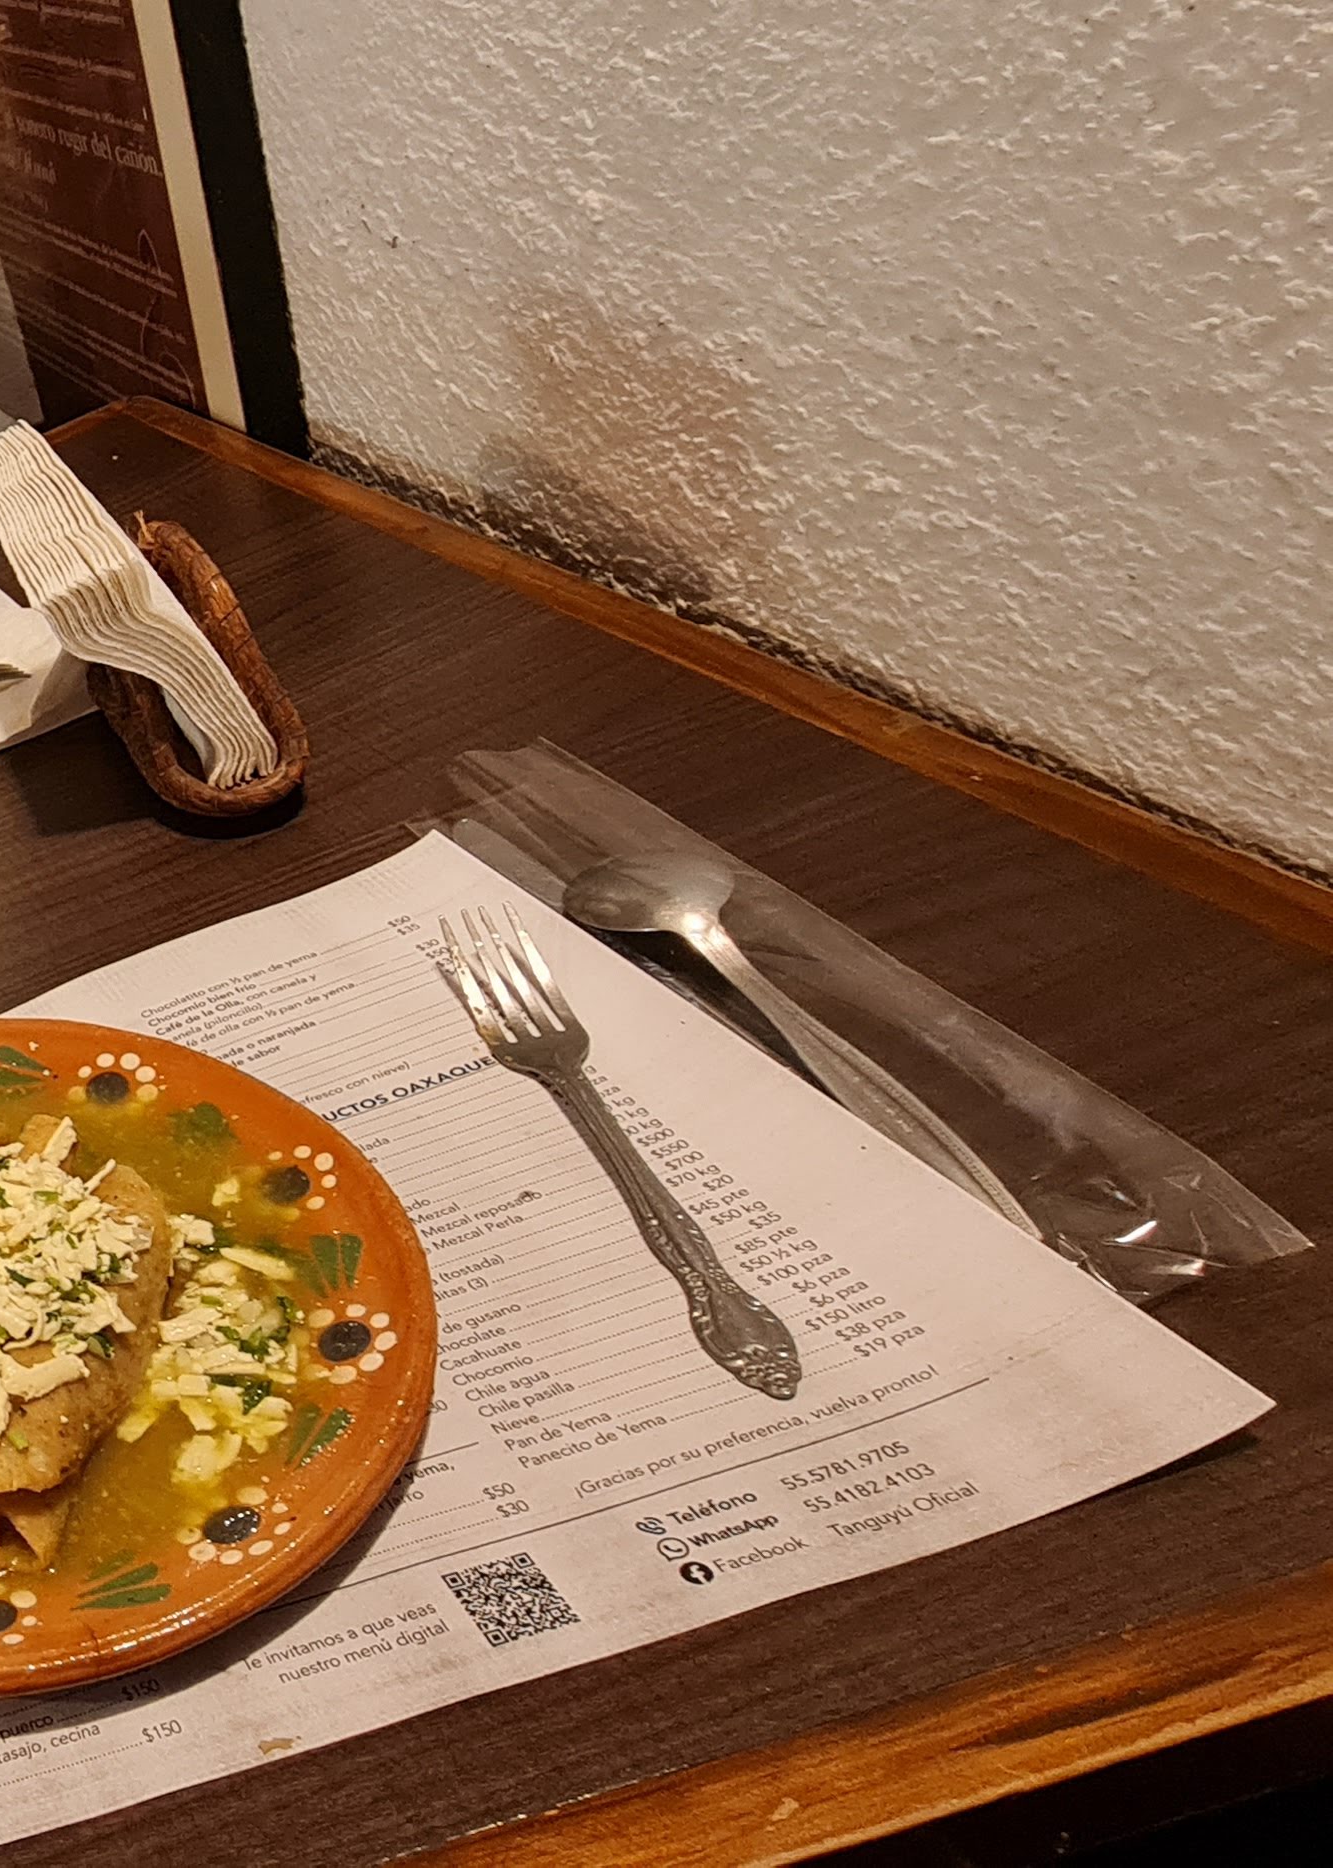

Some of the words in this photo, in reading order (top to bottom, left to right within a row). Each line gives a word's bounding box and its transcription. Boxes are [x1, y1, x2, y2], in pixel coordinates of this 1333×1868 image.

[140, 990, 206, 1018] Chocolatito
[207, 982, 229, 992] con
[243, 969, 266, 981] pan
[267, 963, 283, 972] de
[284, 952, 317, 967] yema
[387, 915, 411, 927] $50
[321, 1093, 388, 1124] UCTOS
[391, 1052, 496, 1097] OAXAQUE
[420, 1213, 472, 1237] Mezcal
[473, 1190, 542, 1220] reposado
[650, 1139, 689, 1159] $550
[431, 1226, 484, 1250] Mezcal
[483, 1215, 524, 1232] Perla
[664, 1150, 704, 1170] $700
[438, 1253, 505, 1283] (tostada)
[702, 1174, 734, 1191] $20
[439, 1340, 522, 1370] Cacahuate
[739, 1254, 773, 1272] $50
[789, 1239, 818, 1252] kg
[451, 1356, 533, 1385] Chocomío
[756, 1264, 799, 1286] $100
[800, 1253, 833, 1272] pza
[464, 1383, 507, 1401] Chile
[509, 1370, 550, 1389] agua
[791, 1279, 817, 1293] $6
[817, 1267, 851, 1286] pza
[477, 1399, 520, 1417] Chile
[522, 1381, 575, 1407] pasilla
[809, 1293, 835, 1307] $6
[835, 1281, 869, 1301] pza
[490, 1415, 540, 1434] Nieve
[804, 1308, 849, 1333] $150
[846, 1296, 886, 1314] litro
[503, 1436, 538, 1451] Pan
[539, 1427, 563, 1441] de
[560, 1412, 612, 1432] Yema
[834, 1322, 871, 1341] $38
[871, 1310, 906, 1331] pza
[517, 1441, 592, 1468] Panecito
[594, 1431, 618, 1445] de
[615, 1416, 667, 1435] Yema
[853, 1337, 887, 1357] $19
[890, 1325, 925, 1346] pza
[646, 1455, 677, 1475] por
[680, 1448, 701, 1461] su
[703, 1416, 809, 1457] preferencia,
[809, 1394, 869, 1419] vuelva
[871, 1364, 939, 1402] pronto!
[482, 1482, 515, 1500] $50
[497, 1499, 529, 1518] $30
[665, 1492, 757, 1524] Teléfono
[779, 1440, 909, 1490] 55.5781.9705
[686, 1515, 779, 1547] WhatsApp
[802, 1463, 935, 1512] 55.4182.4103
[712, 1536, 810, 1572] Facebook
[825, 1504, 913, 1547] Tanguyú
[912, 1481, 980, 1511] Oficial
[240, 1655, 262, 1670] Te
[265, 1633, 344, 1664] invitamos
[346, 1629, 358, 1639] a
[361, 1617, 395, 1637] que
[396, 1603, 437, 1622] veas
[278, 1657, 341, 1683] nuestro
[343, 1637, 393, 1663] menú
[395, 1618, 450, 1646] digital
[50, 1725, 100, 1747] cecina
[121, 1679, 162, 1701] $150
[141, 1719, 182, 1743] $150
